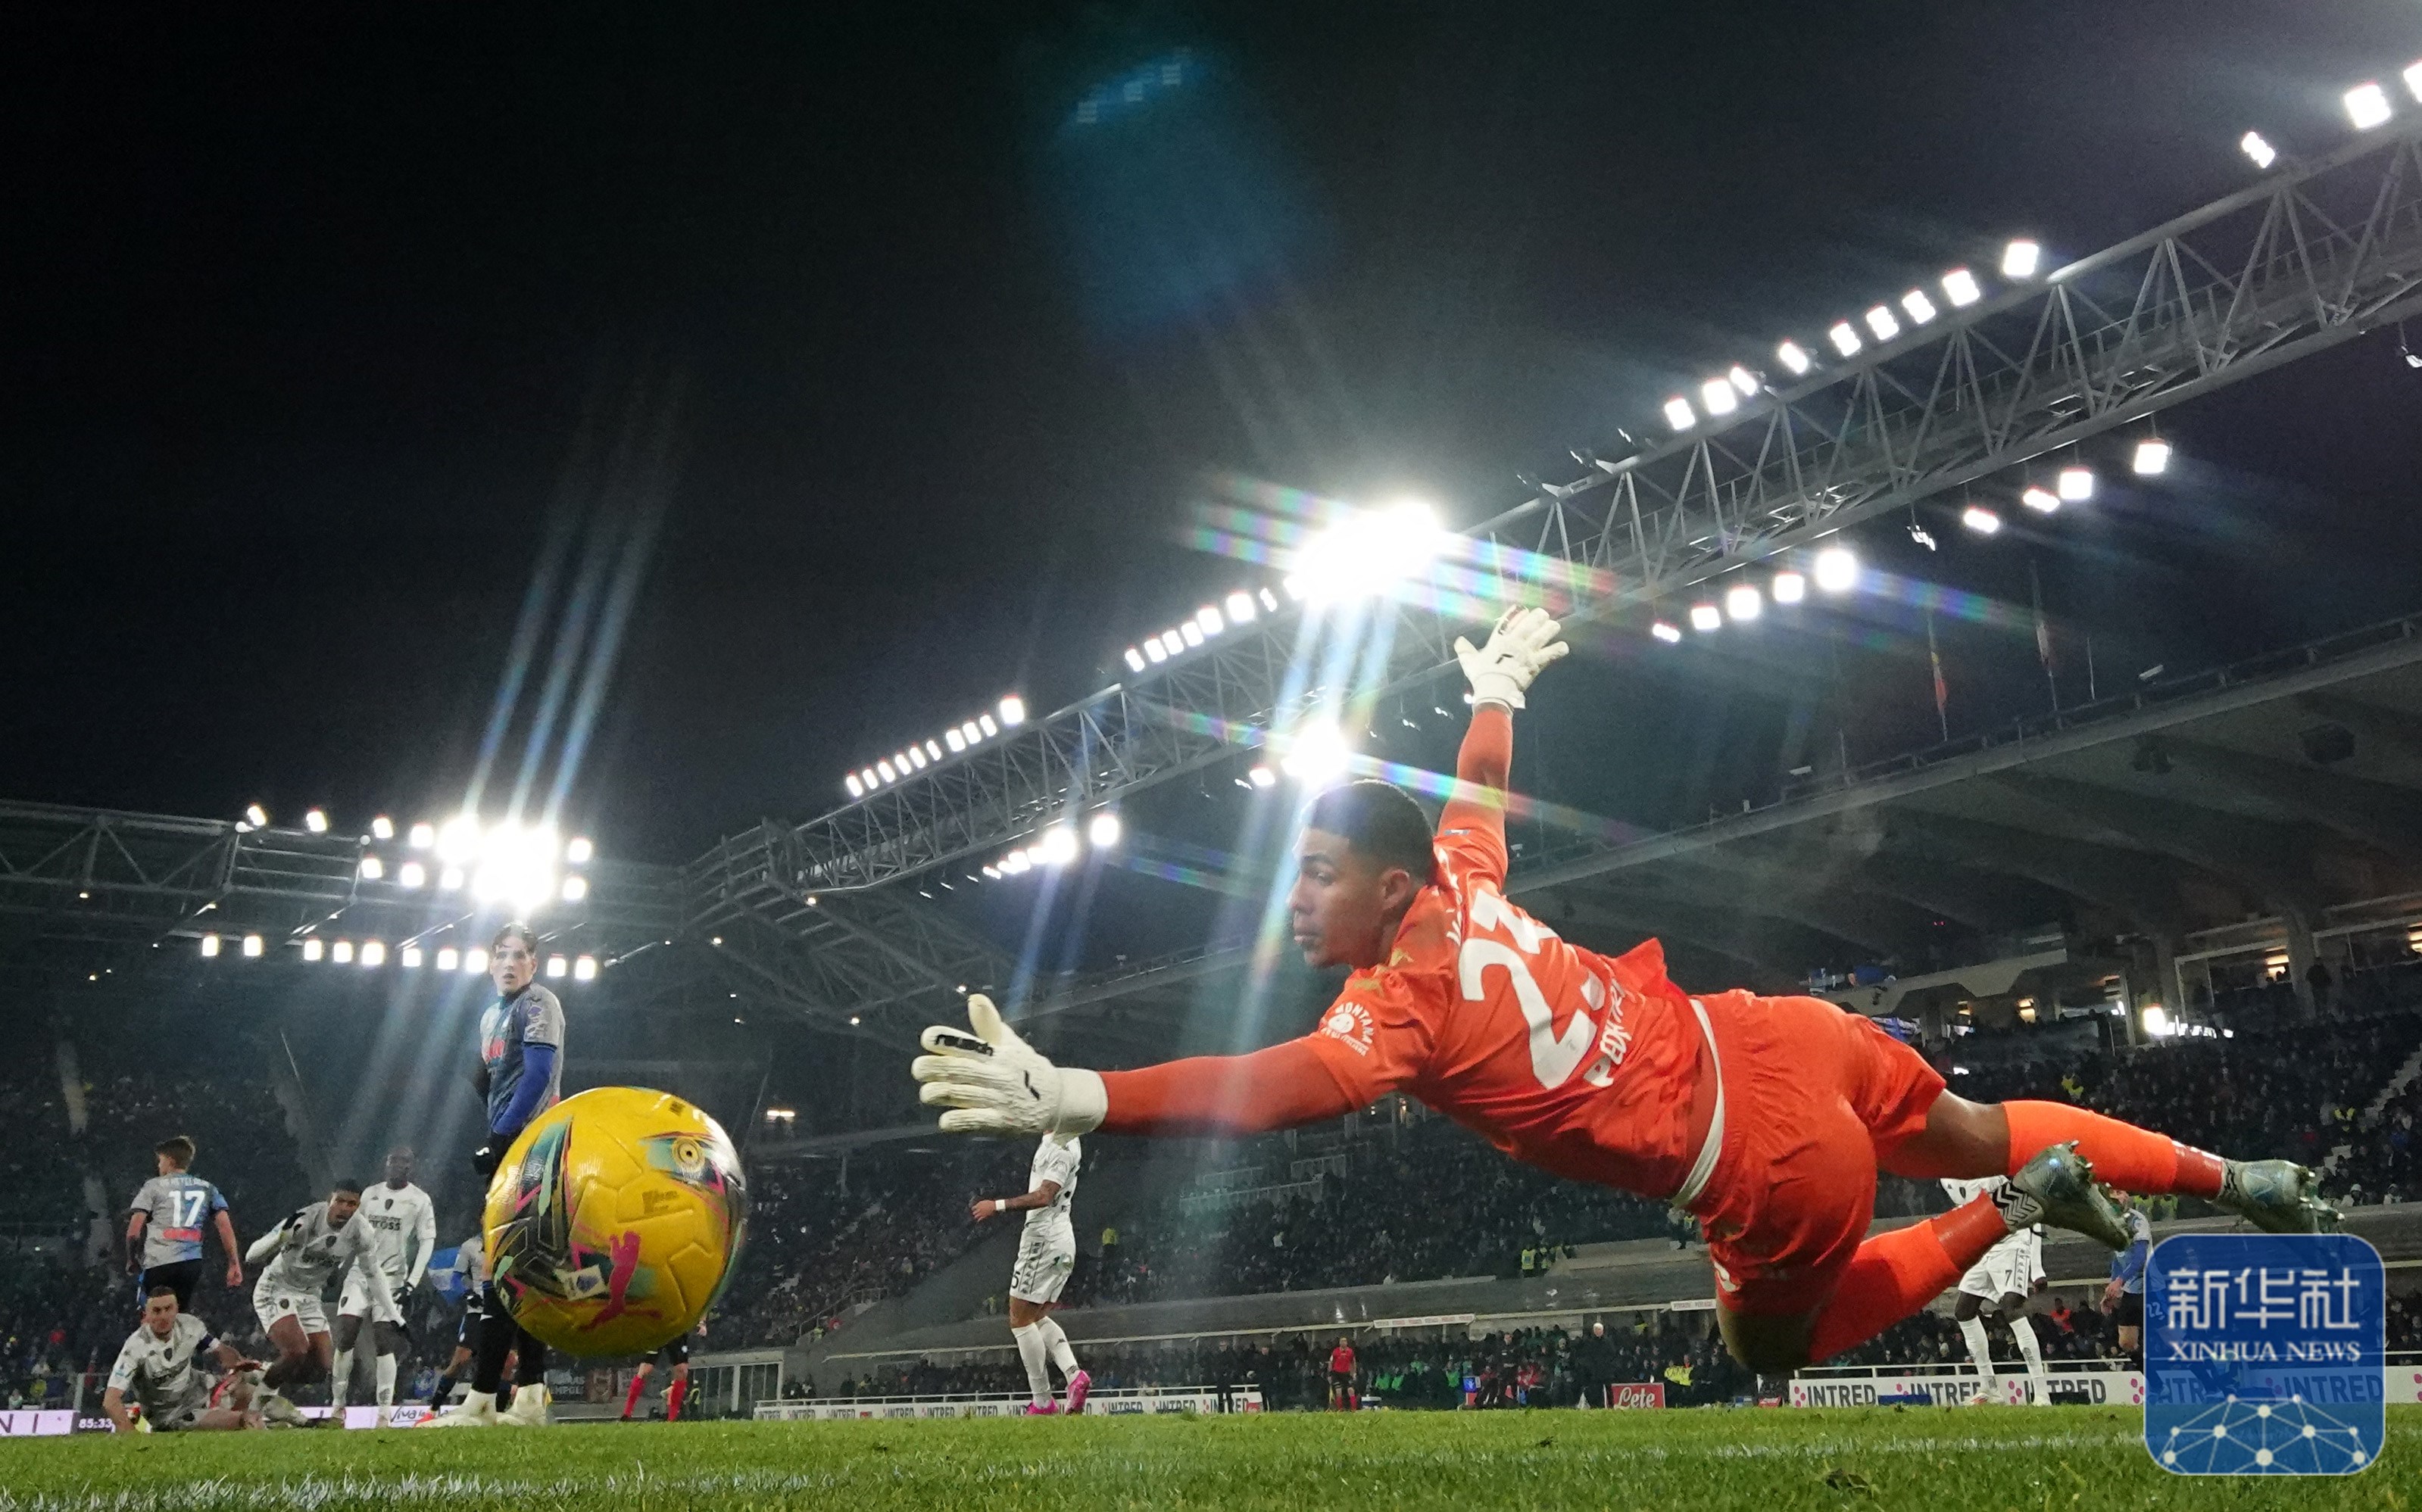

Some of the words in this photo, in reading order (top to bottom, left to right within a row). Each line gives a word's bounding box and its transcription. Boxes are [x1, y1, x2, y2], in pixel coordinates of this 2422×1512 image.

[168, 1190, 205, 1227] 17
[2005, 1269, 2012, 1286] 7
[1614, 1386, 1656, 1410] Lete
[1807, 1384, 1876, 1407] INTRED
[2284, 1374, 2383, 1404] INTRED
[79, 1417, 113, 1429] 85:33
